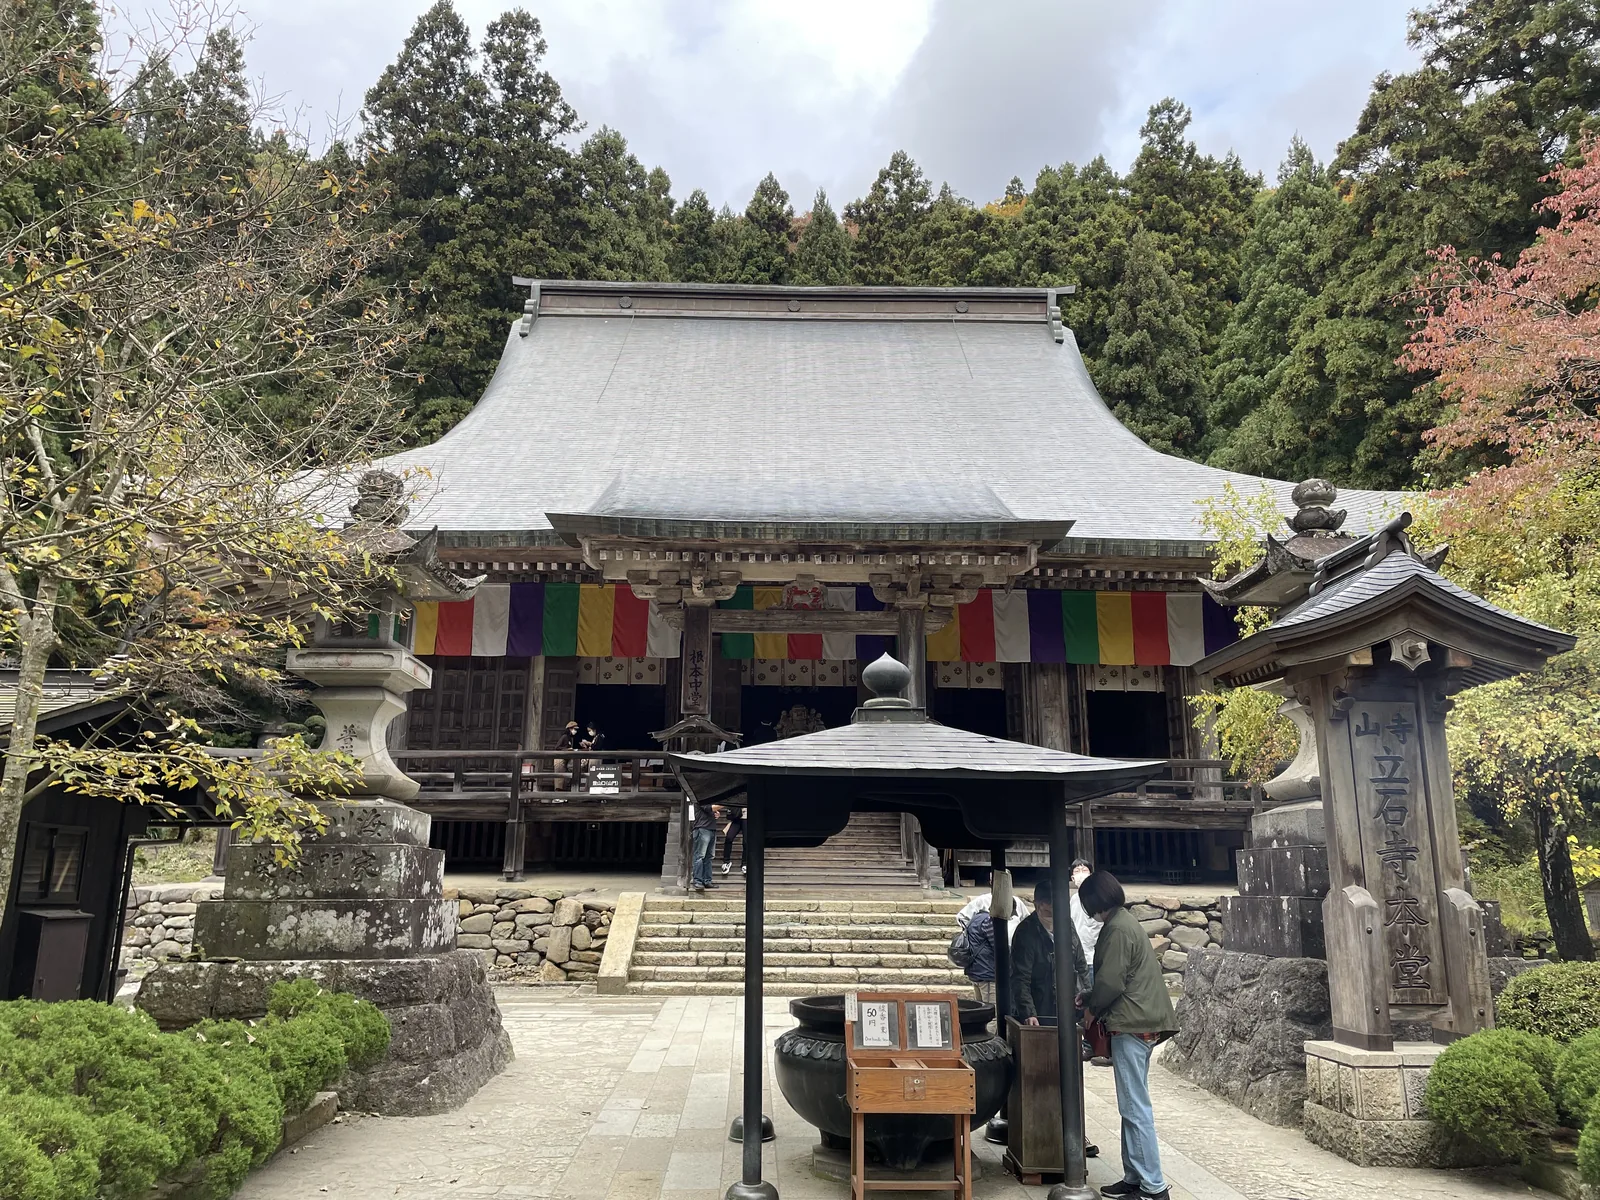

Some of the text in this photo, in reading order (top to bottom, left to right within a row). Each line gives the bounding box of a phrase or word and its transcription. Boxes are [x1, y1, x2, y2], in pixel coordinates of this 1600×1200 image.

[687, 649, 705, 708] 根本中堂
[1355, 711, 1415, 745] 山寺
[1369, 745, 1431, 990] 立石寺本堂
[866, 1007, 877, 1027] 50円
